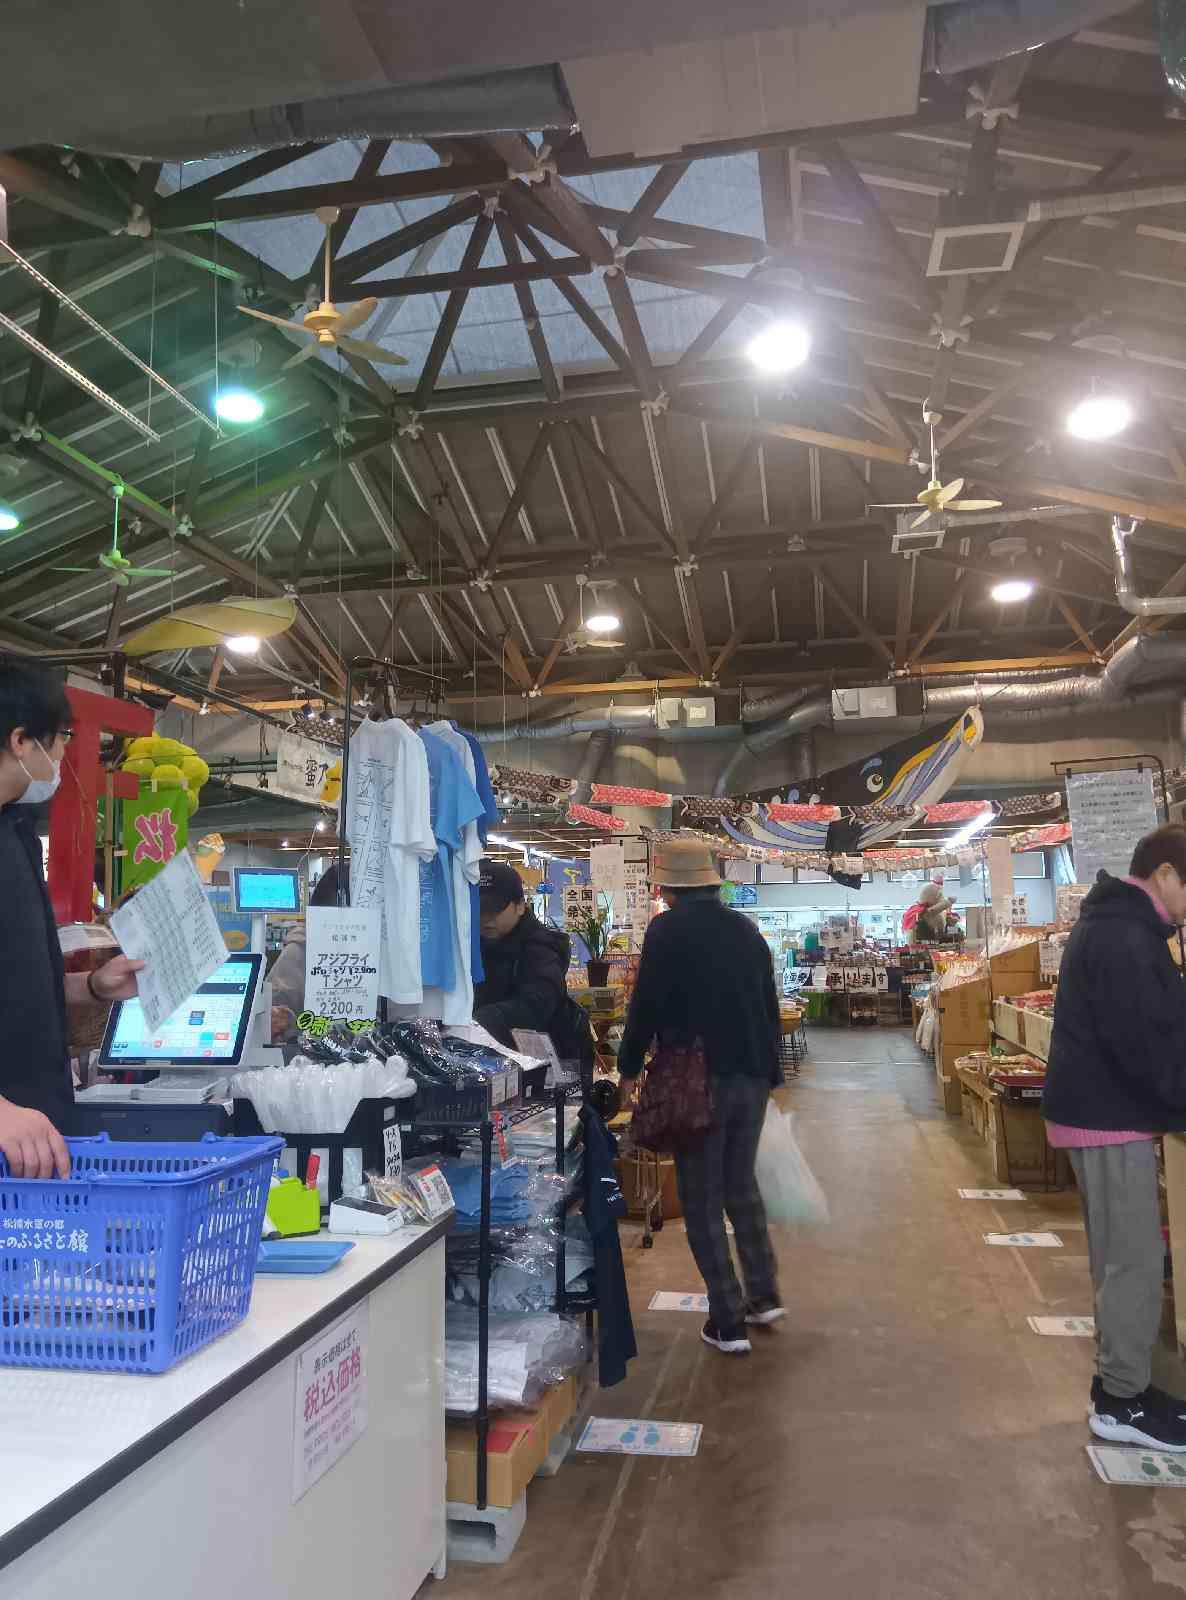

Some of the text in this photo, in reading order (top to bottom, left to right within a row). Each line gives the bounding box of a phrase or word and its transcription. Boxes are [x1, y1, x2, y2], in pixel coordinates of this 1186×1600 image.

[317, 953, 370, 966] アジフライ
[303, 1345, 362, 1422] 税込価格
